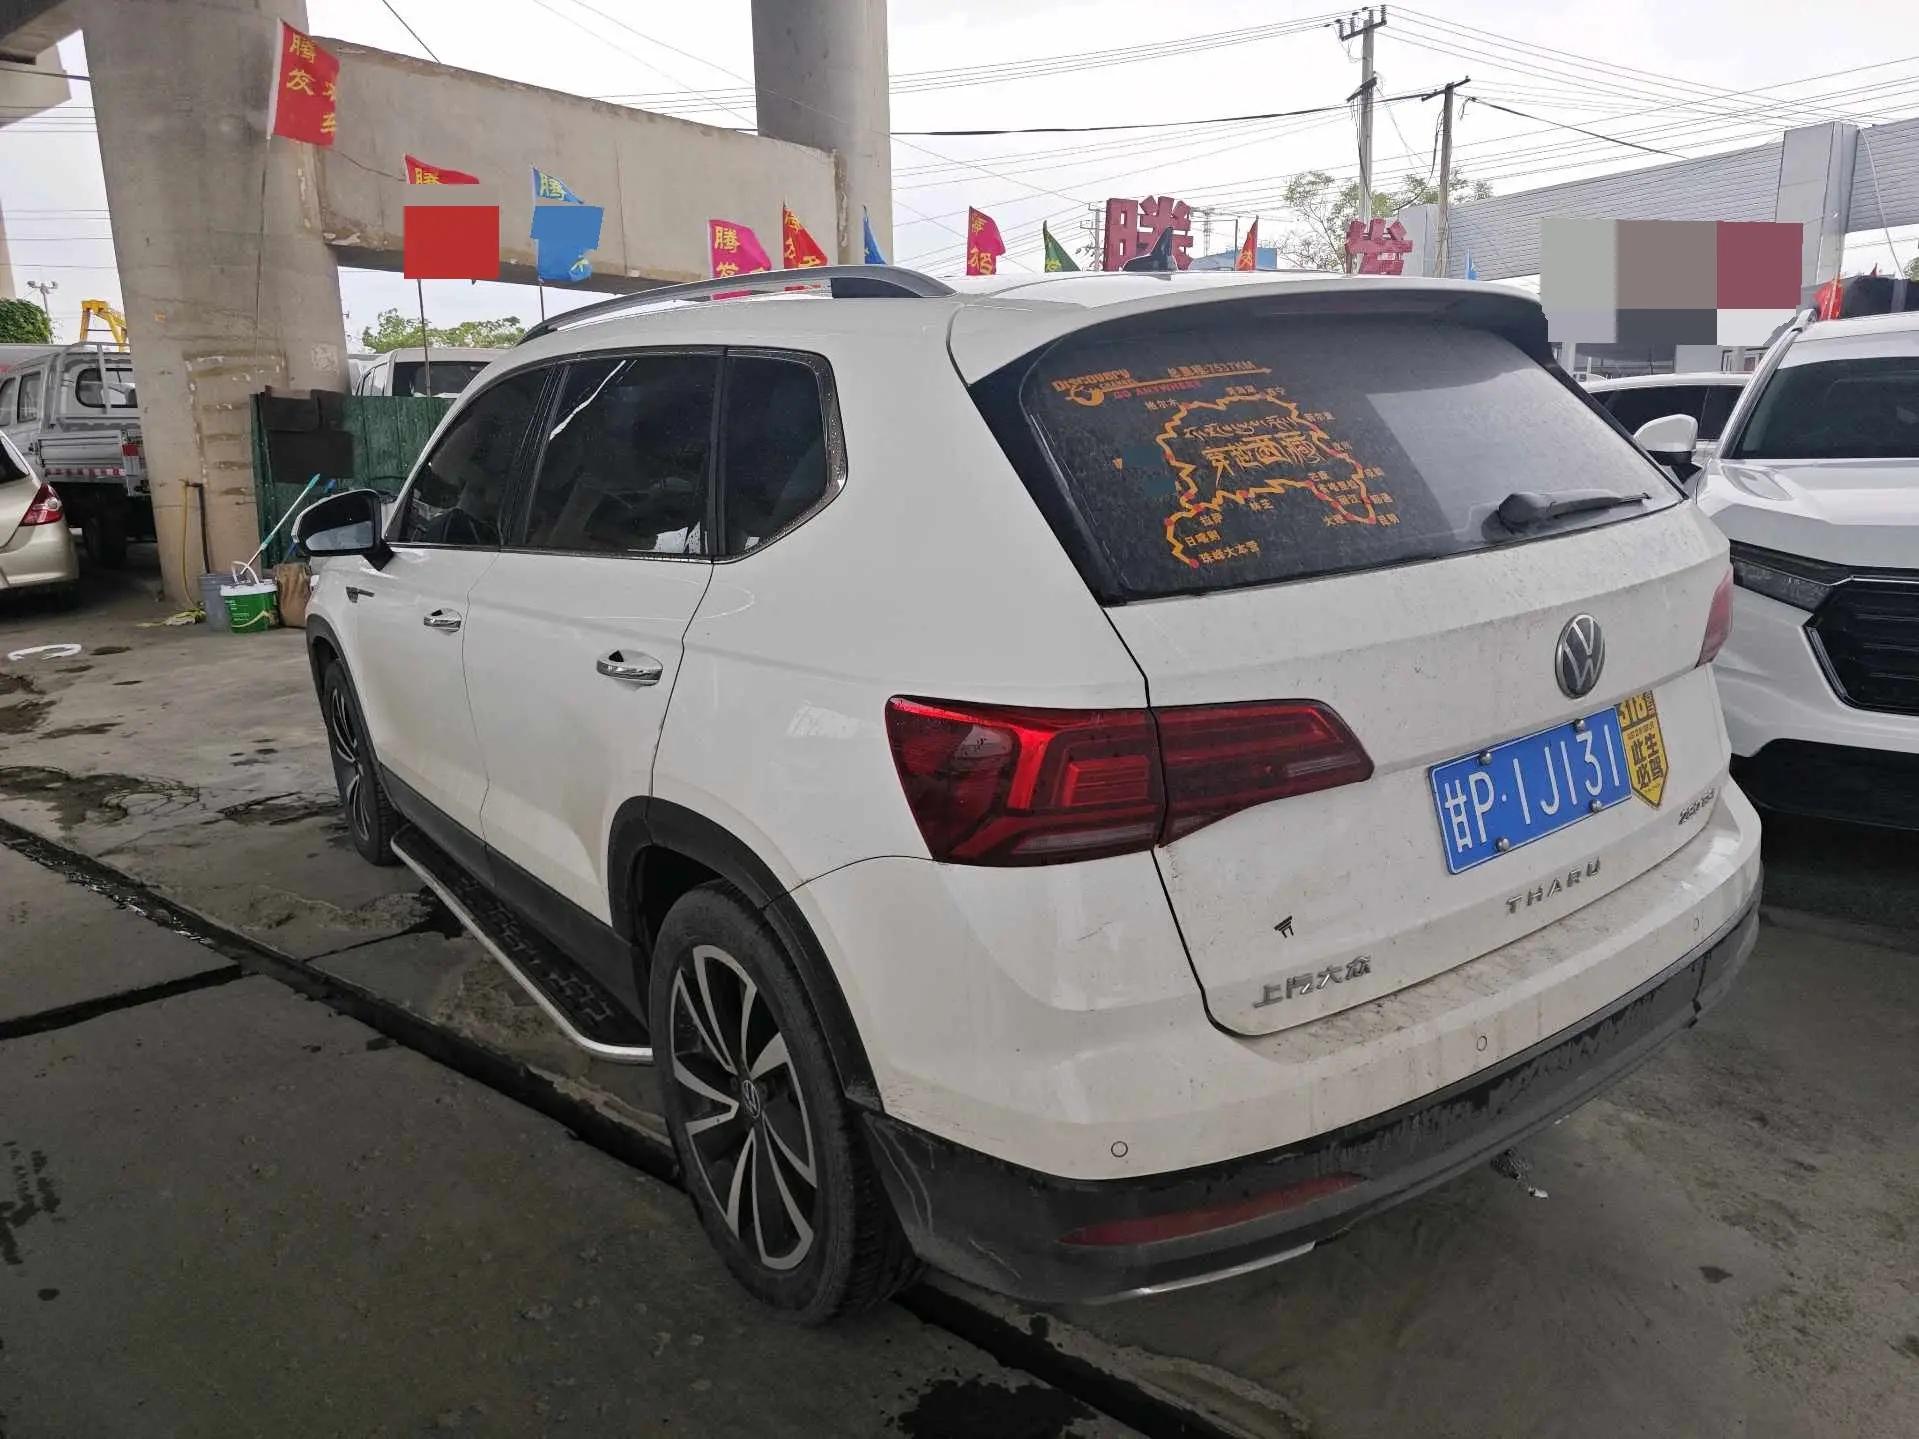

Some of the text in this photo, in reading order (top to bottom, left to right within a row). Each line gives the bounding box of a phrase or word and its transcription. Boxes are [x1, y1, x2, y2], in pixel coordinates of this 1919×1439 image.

[1504, 855, 1602, 915] THARU
[1252, 954, 1374, 1009] 上汽大众
